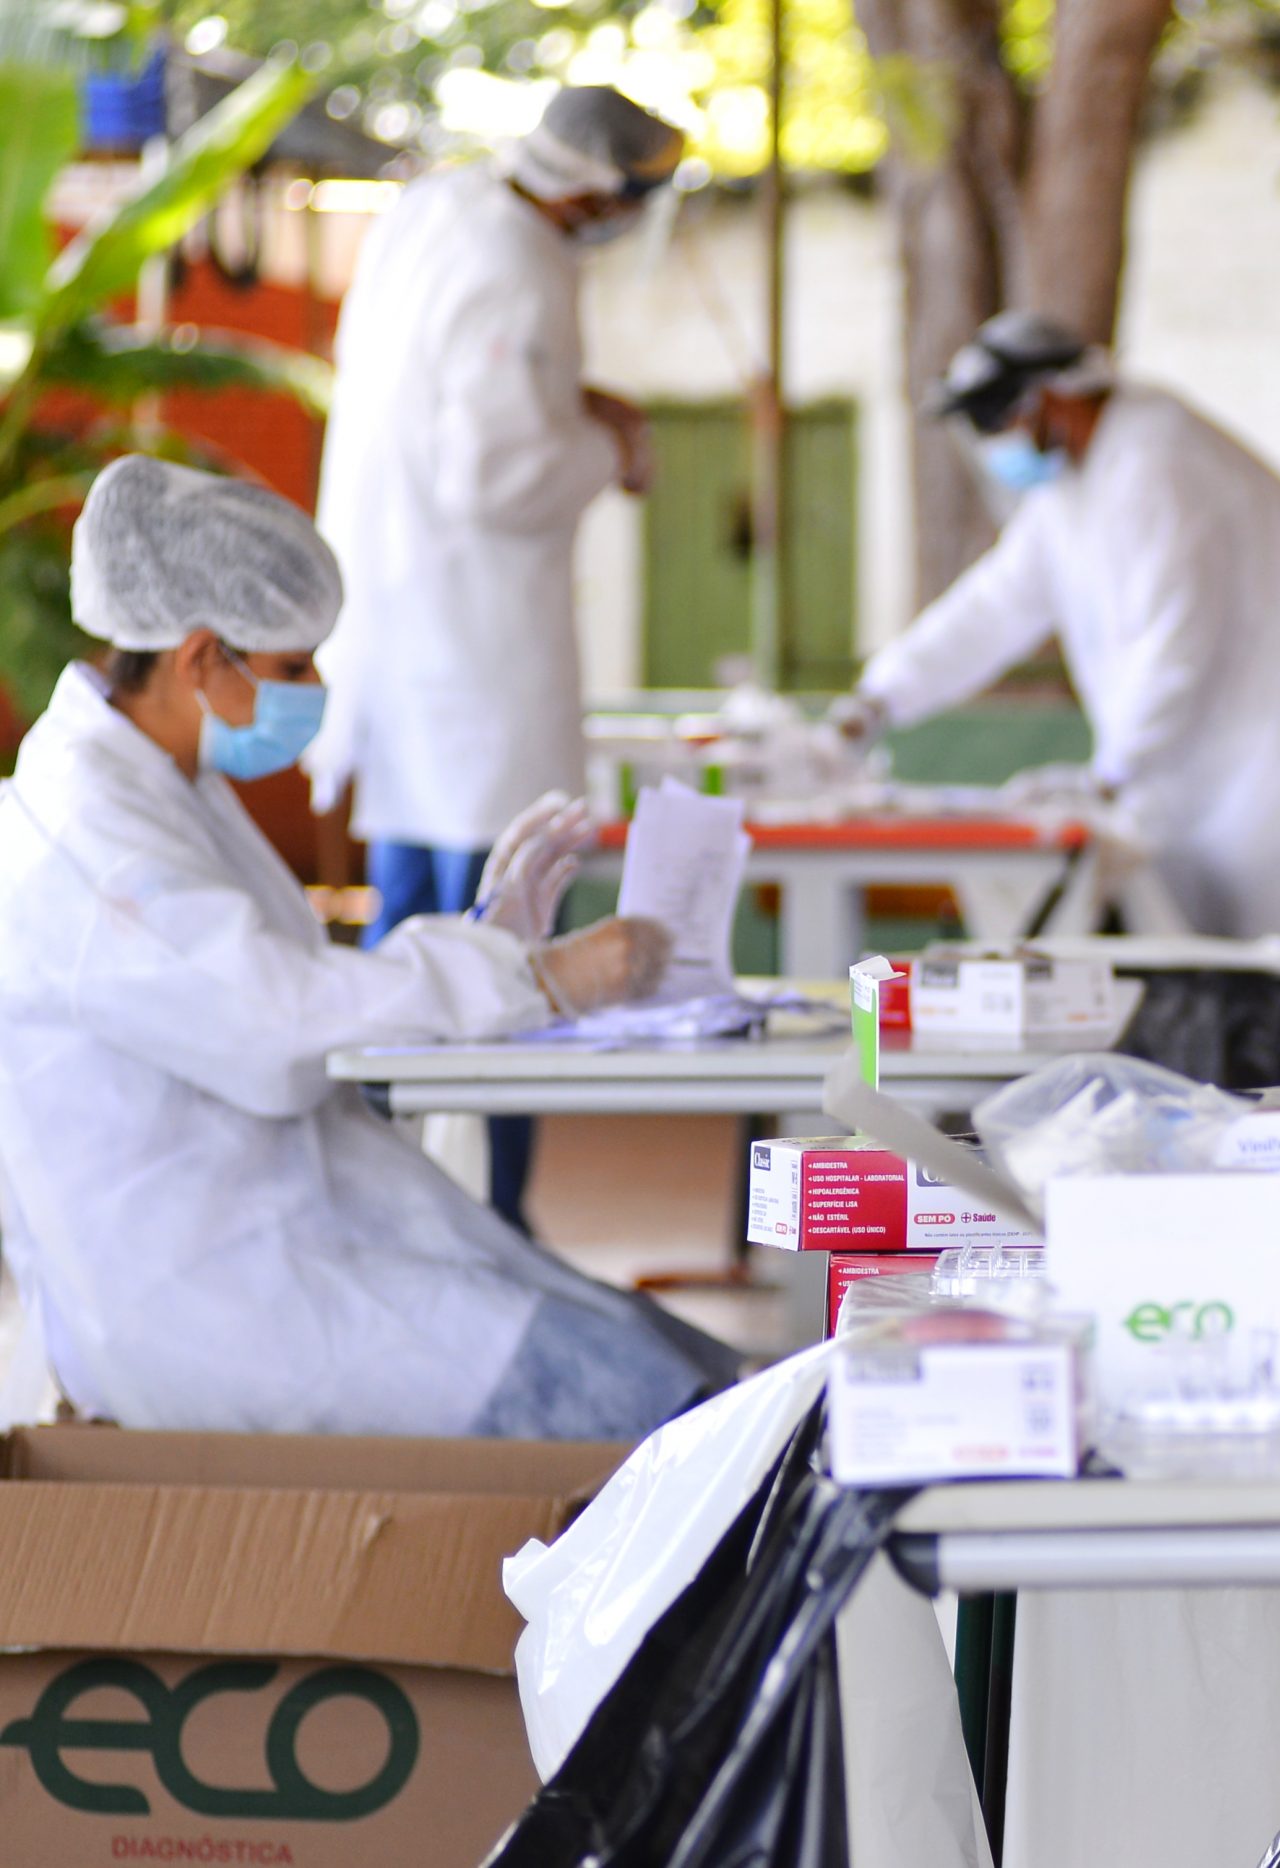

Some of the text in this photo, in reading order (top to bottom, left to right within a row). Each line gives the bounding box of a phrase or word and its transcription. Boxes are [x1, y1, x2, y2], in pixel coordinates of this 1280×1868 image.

[845, 1200, 858, 1208] LISA
[812, 1212, 849, 1221] NÃO ESTÉRIL
[917, 1215, 936, 1223] SEM
[973, 1213, 996, 1222] Saúde
[812, 1225, 886, 1235] DESCARTÁVEL (USO ÚNICO)
[843, 1267, 880, 1275] AMBIDESTRA
[111, 1832, 294, 1864] DIAGNÓSTICA
